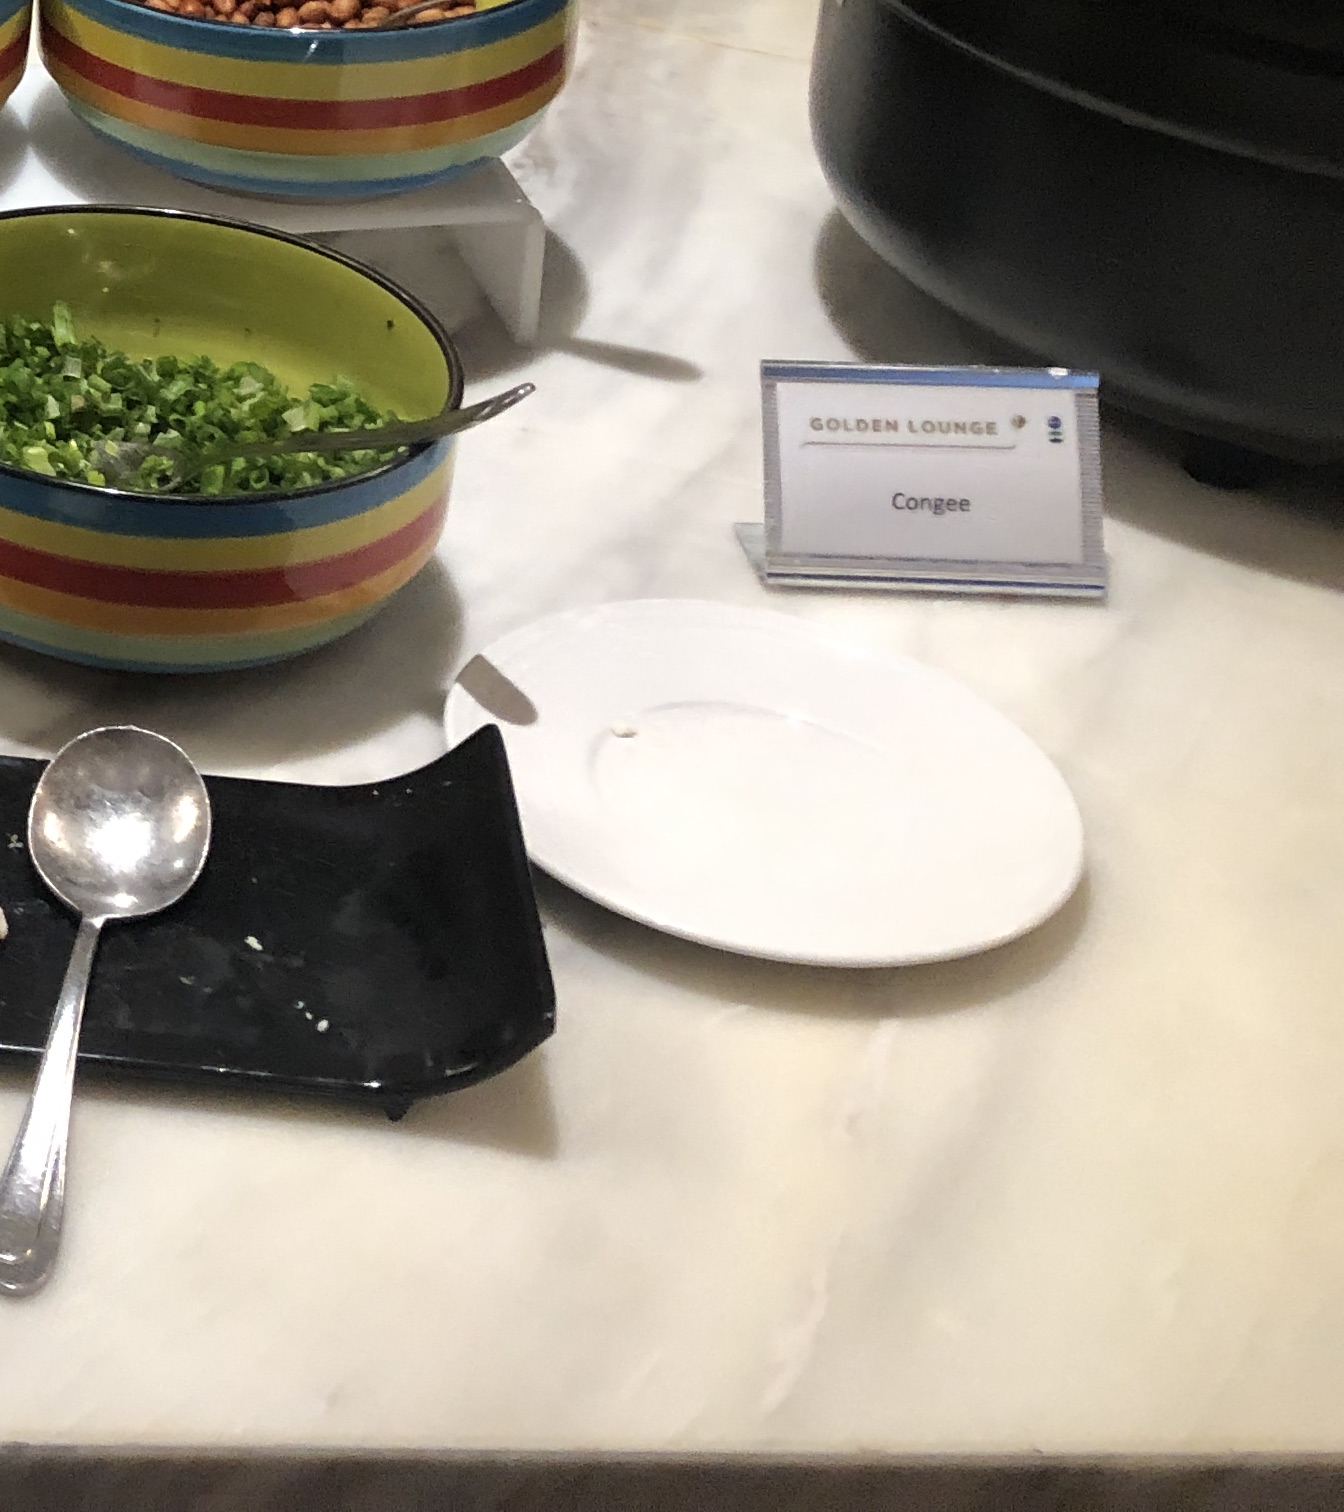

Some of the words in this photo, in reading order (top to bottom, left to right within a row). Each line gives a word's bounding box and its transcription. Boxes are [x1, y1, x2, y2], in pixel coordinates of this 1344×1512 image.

[809, 417, 899, 434] GOLDEN
[908, 419, 999, 436] LOUNGE
[891, 492, 972, 516] Congee
